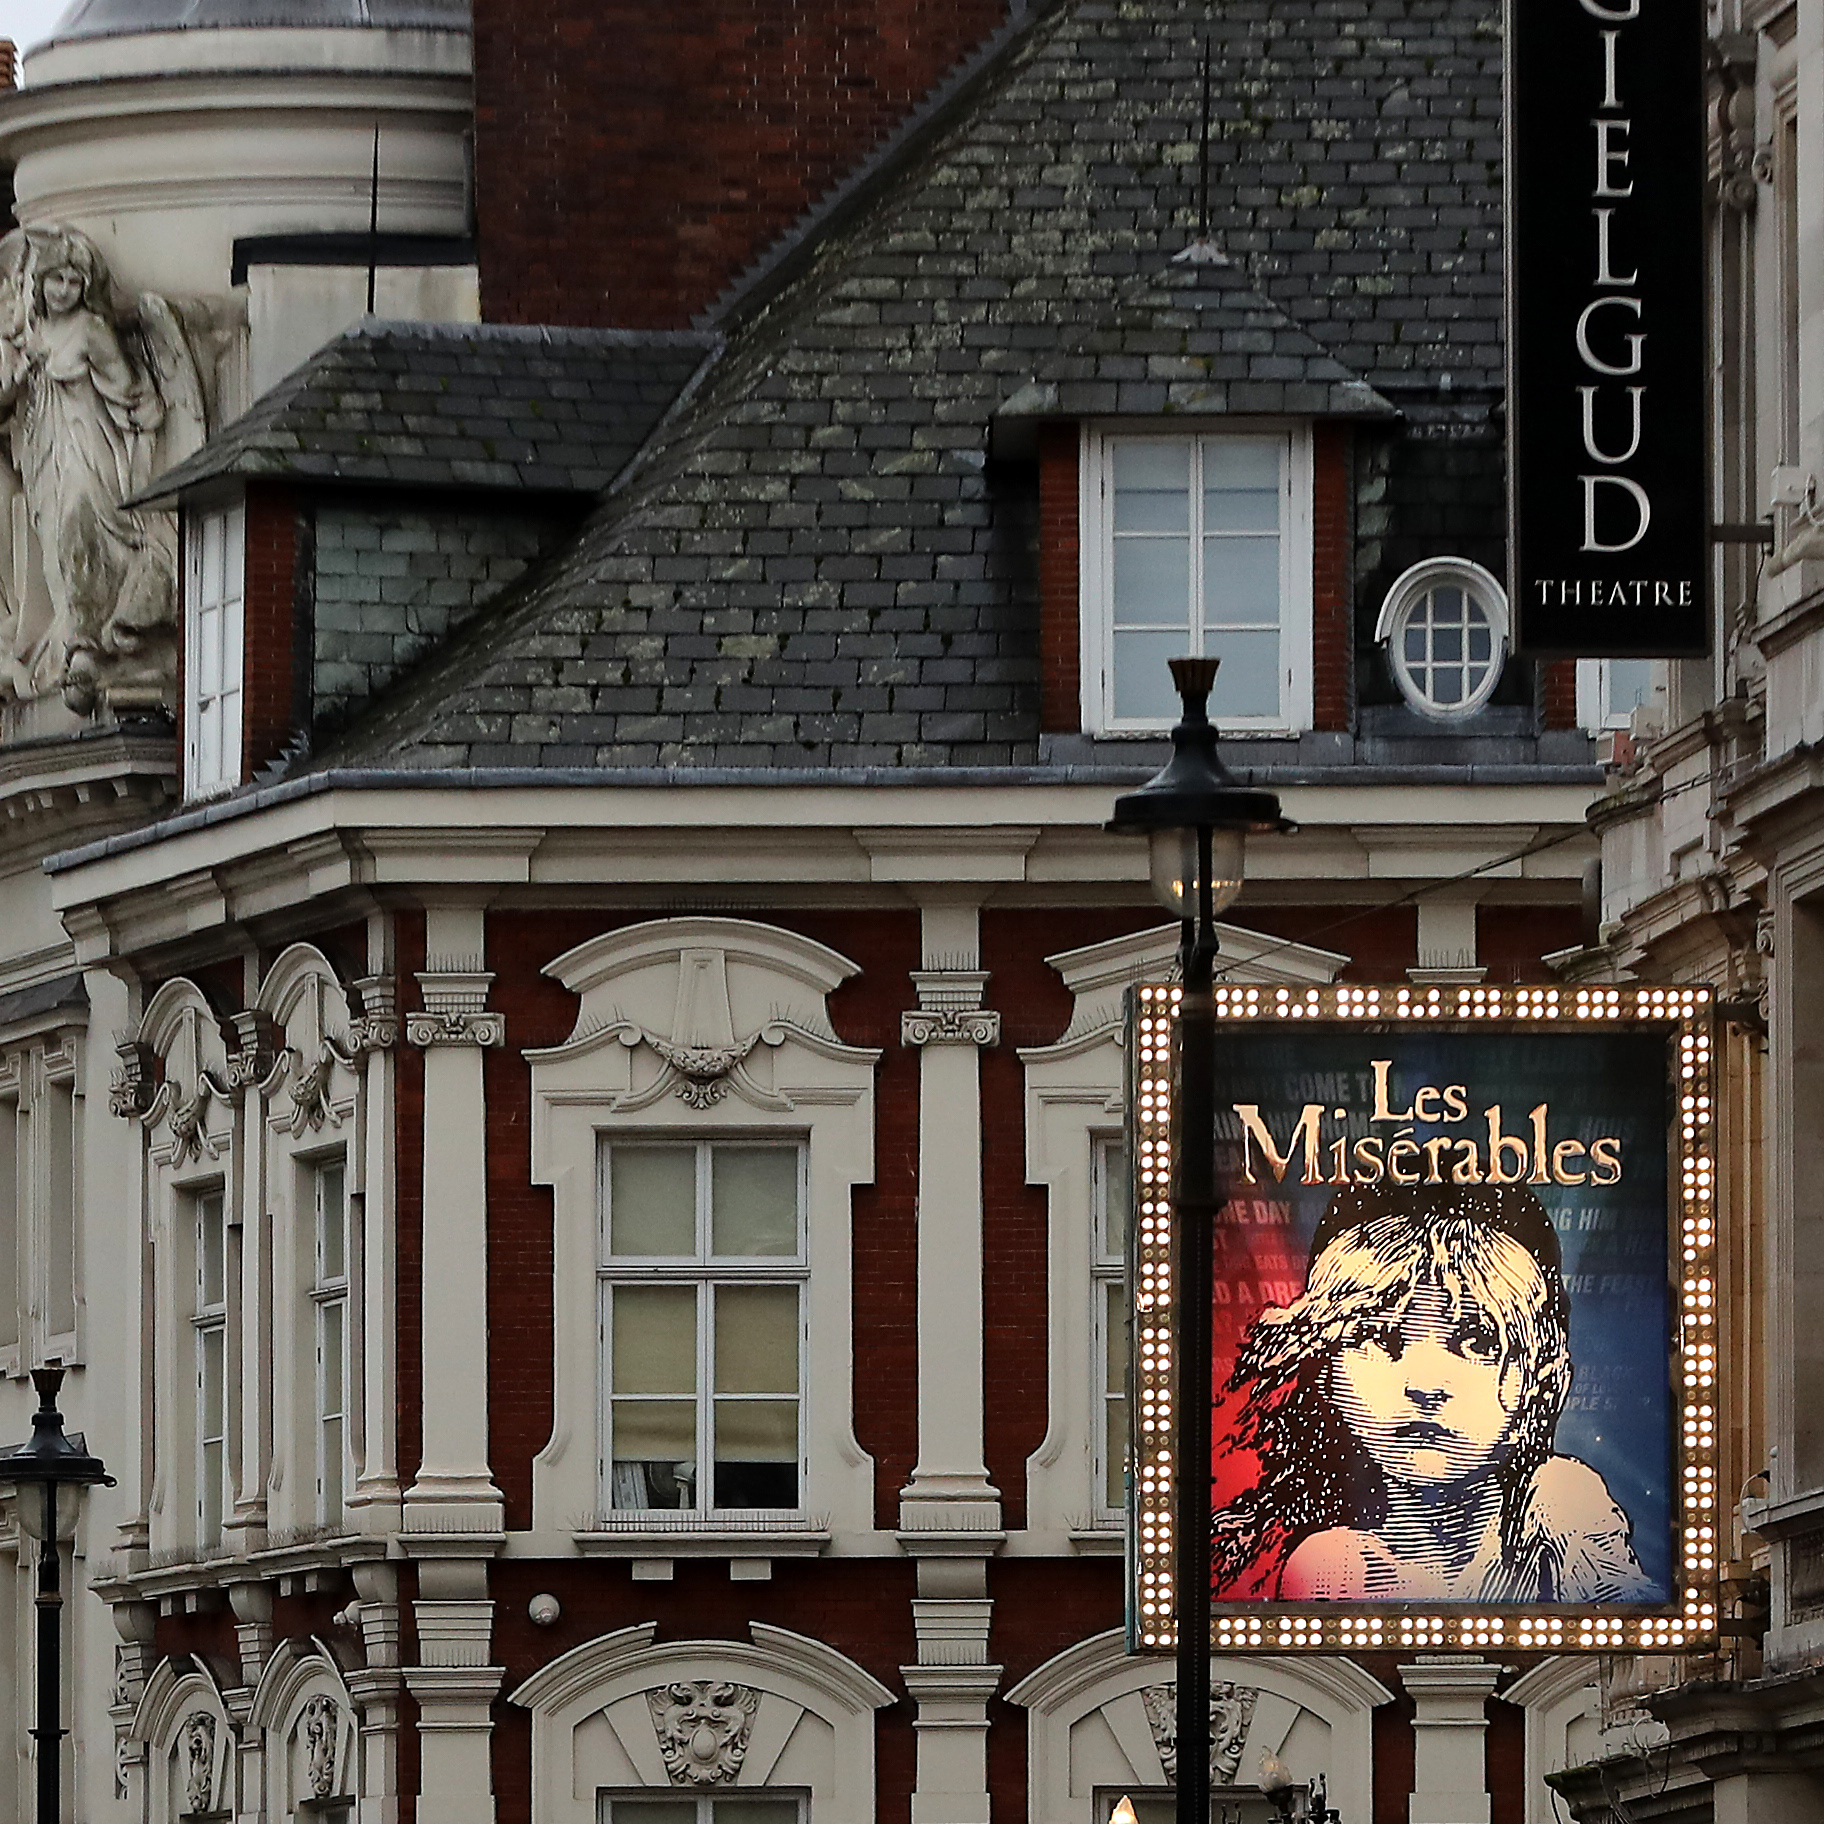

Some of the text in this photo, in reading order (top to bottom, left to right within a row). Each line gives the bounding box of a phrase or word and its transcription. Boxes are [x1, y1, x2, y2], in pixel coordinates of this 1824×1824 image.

[1576, 0, 1651, 553] IELGUD
[1534, 579, 1692, 607] THEATRE
[1369, 1058, 1468, 1124] Les
[1232, 1102, 1623, 1186] Misérables
